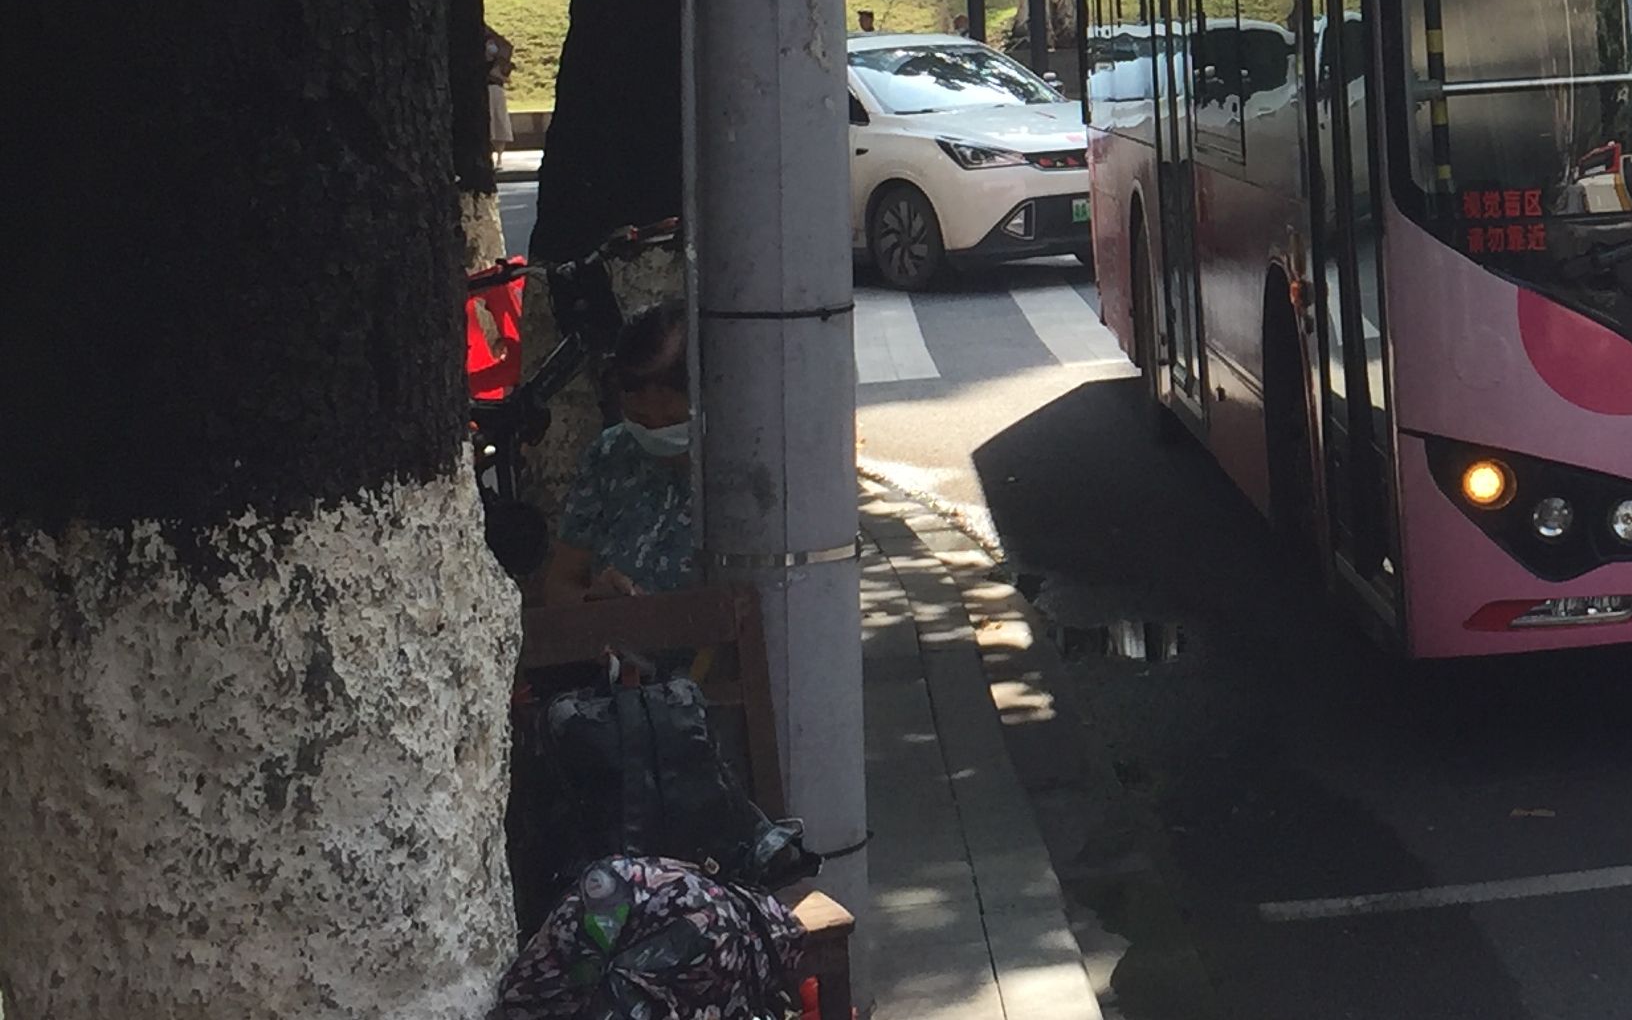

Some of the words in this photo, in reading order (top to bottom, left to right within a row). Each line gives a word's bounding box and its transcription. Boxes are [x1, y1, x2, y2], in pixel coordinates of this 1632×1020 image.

[1463, 188, 1542, 219] 视觉盲区
[1467, 223, 1547, 254] 请勿靠近
